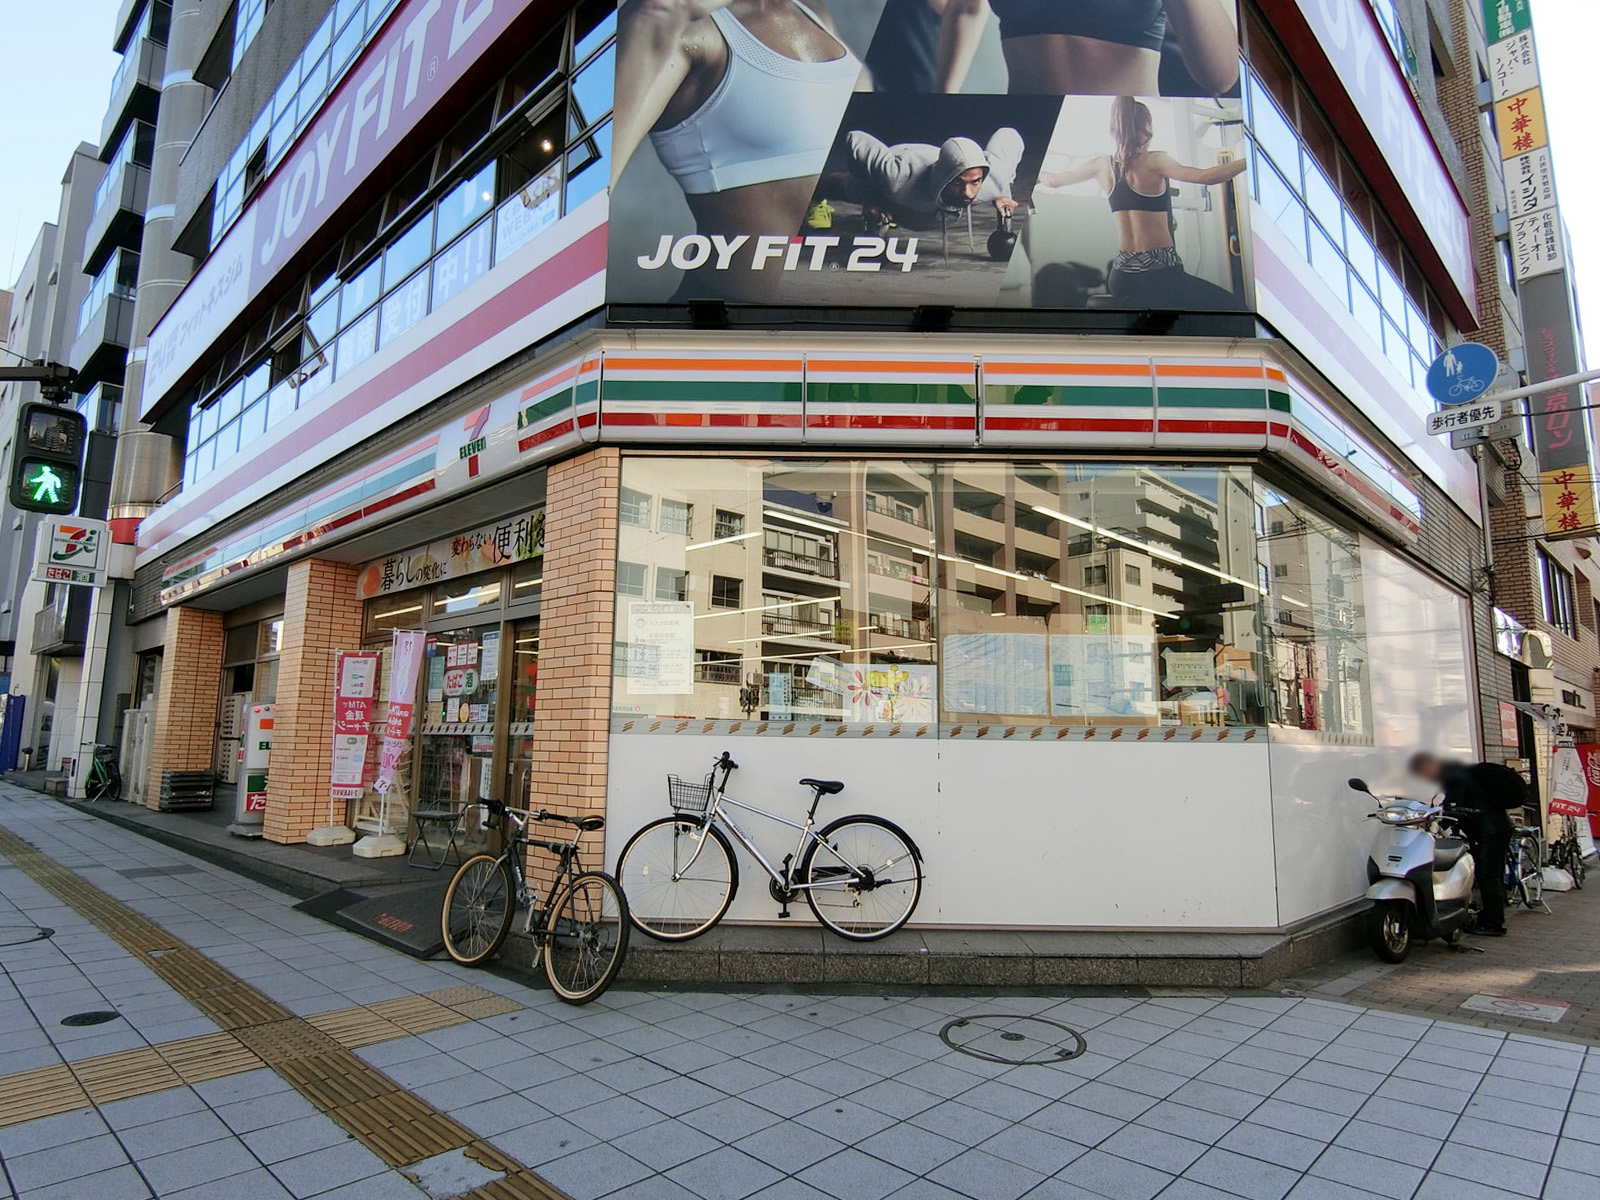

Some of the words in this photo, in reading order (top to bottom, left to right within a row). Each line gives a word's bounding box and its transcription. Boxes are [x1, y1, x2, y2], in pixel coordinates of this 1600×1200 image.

[1507, 98, 1535, 150] 中華楼
[637, 234, 750, 270] JOY
[846, 236, 919, 272] 24
[1432, 405, 1495, 431] 歩行者優先
[1553, 470, 1582, 531] 中華楼
[46, 567, 70, 579] たばこ
[381, 556, 448, 591] 暮らしの変化に
[447, 673, 463, 689] たばこ
